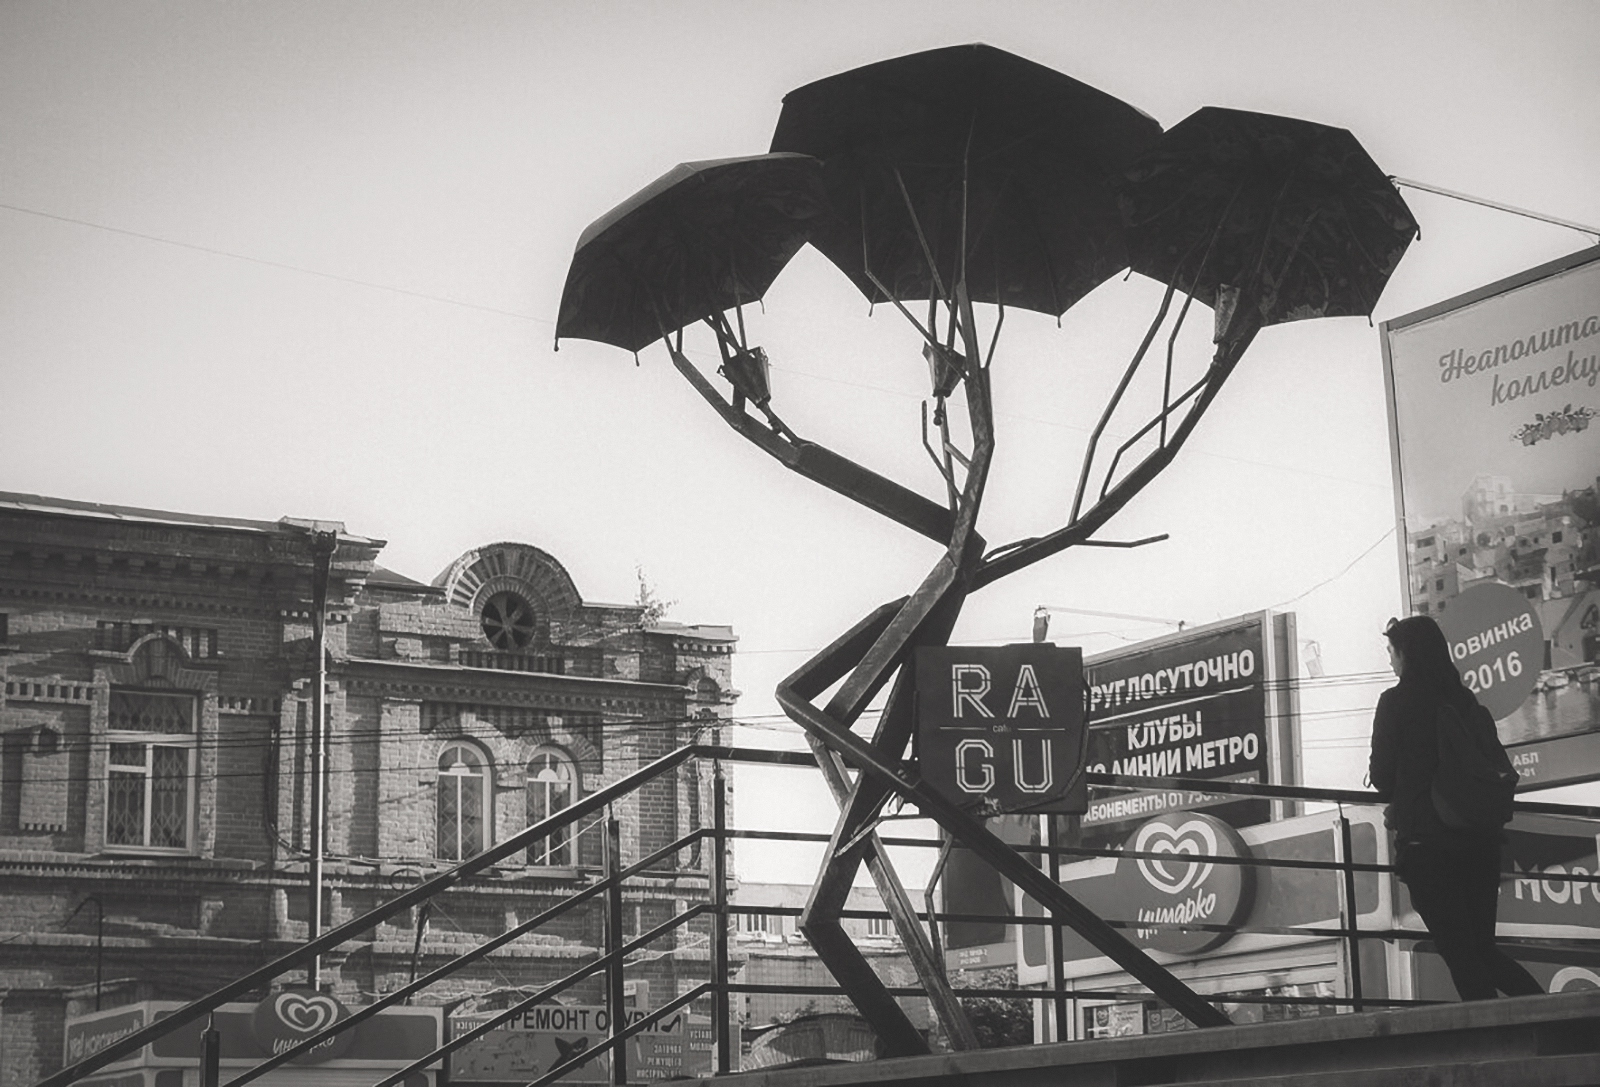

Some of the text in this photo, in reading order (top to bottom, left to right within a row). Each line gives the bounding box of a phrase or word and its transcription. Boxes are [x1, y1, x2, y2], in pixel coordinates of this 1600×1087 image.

[1438, 315, 1600, 383] Неаполита
[1490, 350, 1600, 407] коллекц
[1463, 650, 1523, 695] 2016
[1127, 710, 1203, 751] КЛУБЫ
[1185, 732, 1259, 772] МЕТРО
[1083, 792, 1167, 823] АБОНЕМЕНТЫ
